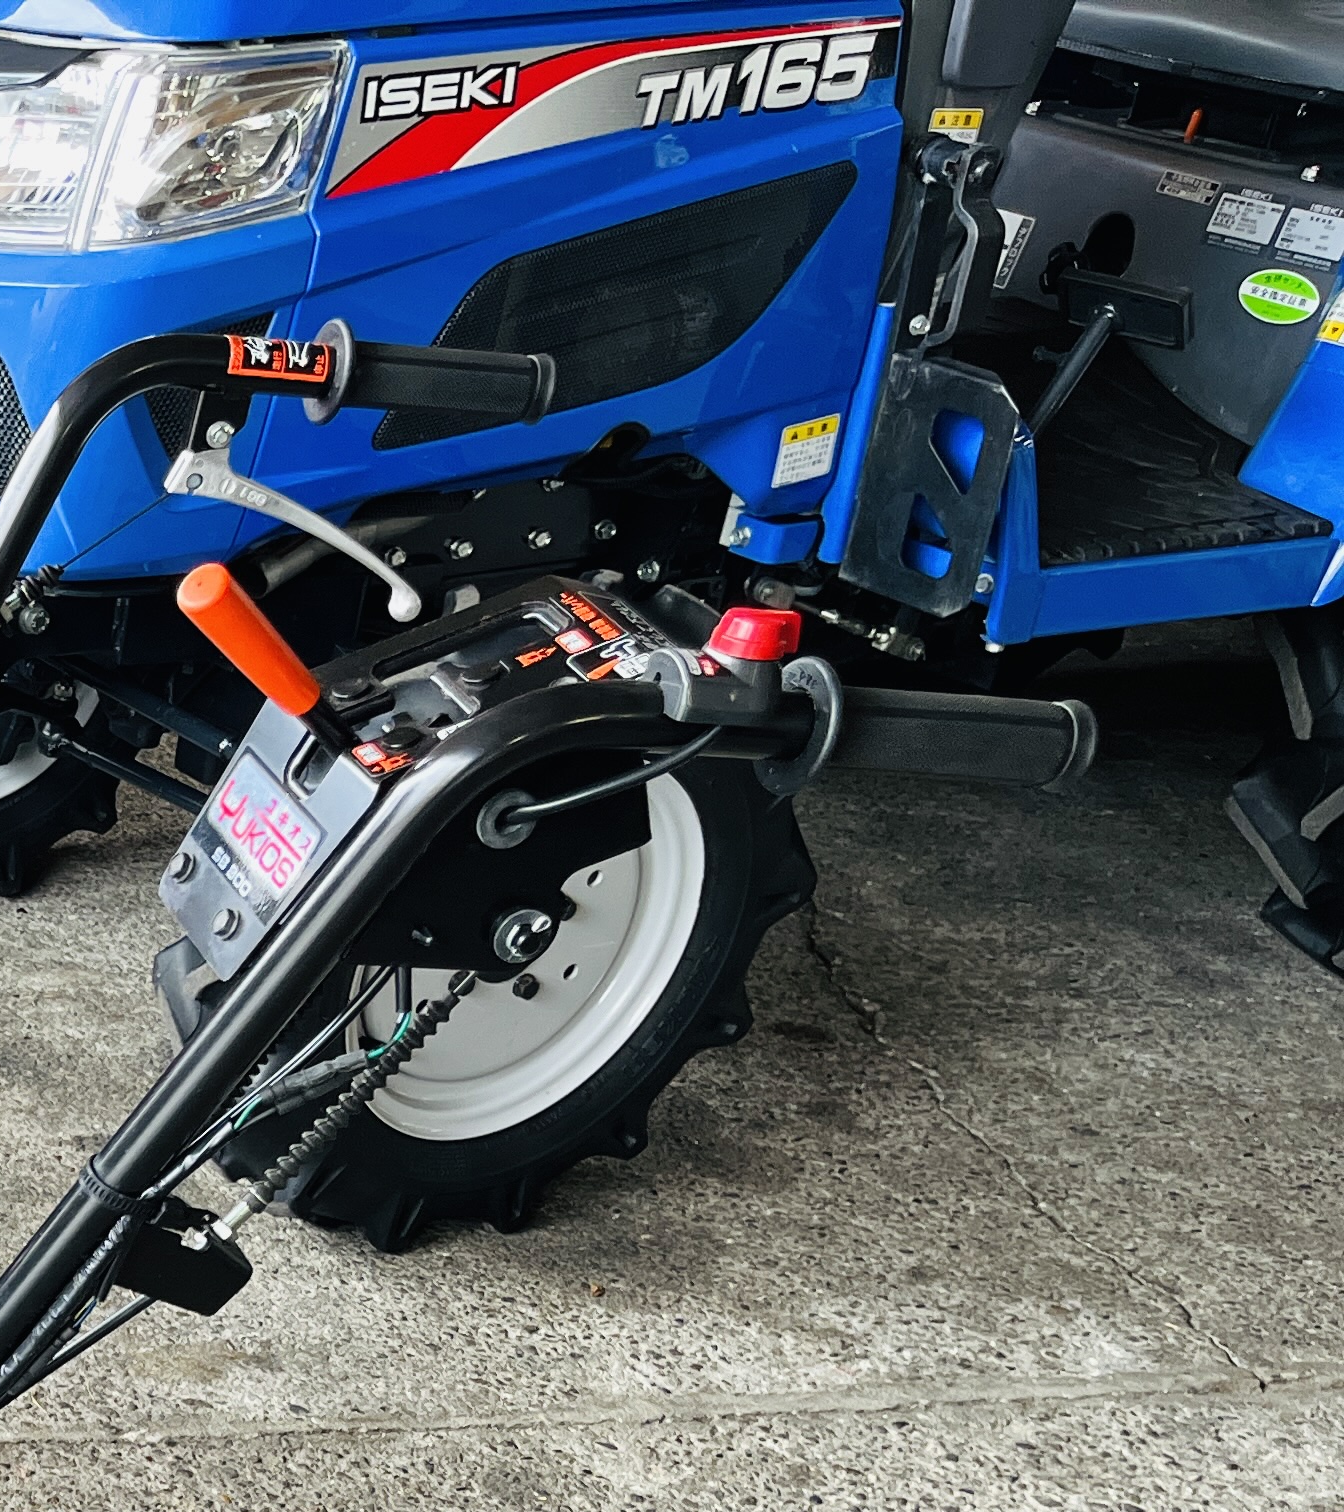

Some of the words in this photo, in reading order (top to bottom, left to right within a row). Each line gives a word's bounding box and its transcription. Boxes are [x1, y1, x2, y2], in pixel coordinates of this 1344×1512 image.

[362, 65, 518, 121] ISEKI
[218, 778, 295, 889] YUKIOS
[264, 798, 312, 853] ユキオス
